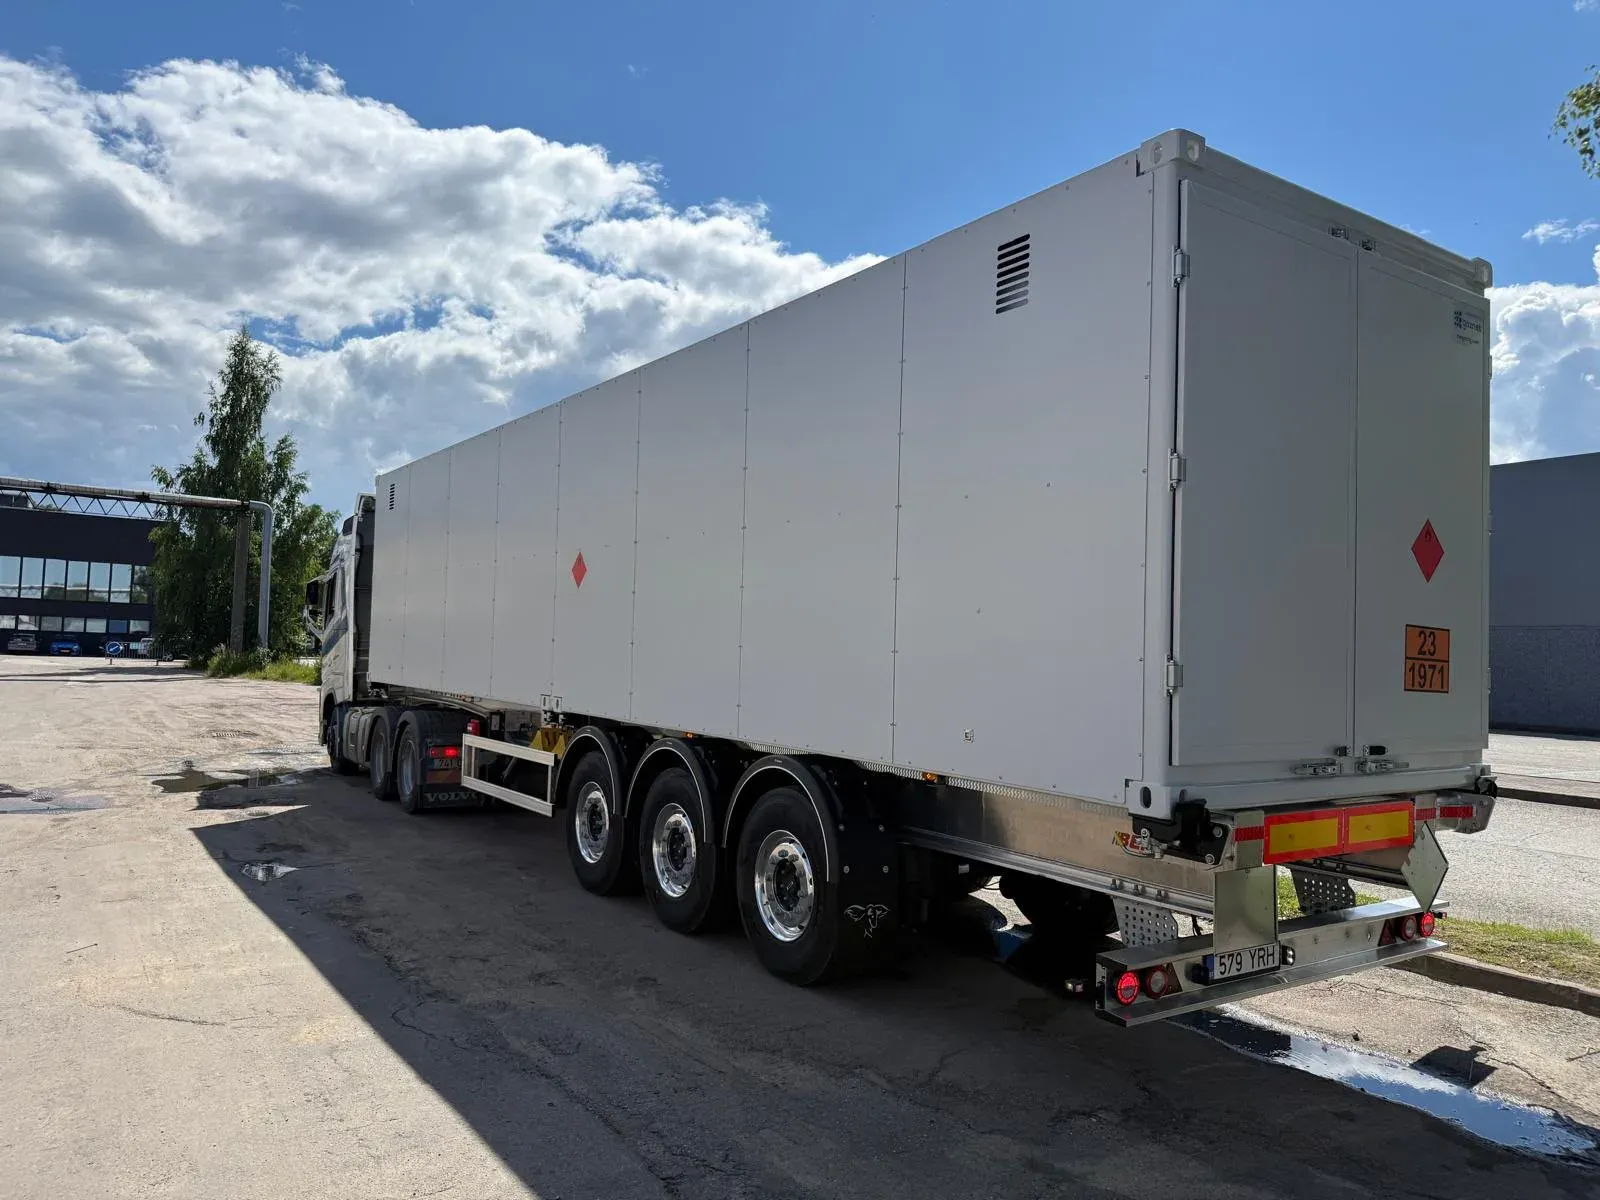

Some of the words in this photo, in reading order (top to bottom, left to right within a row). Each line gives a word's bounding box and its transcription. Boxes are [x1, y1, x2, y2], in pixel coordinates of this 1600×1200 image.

[1417, 630, 1437, 656] 23
[1408, 662, 1445, 689] 1971
[1219, 952, 1243, 975] 579
[1249, 945, 1275, 969] YRH
